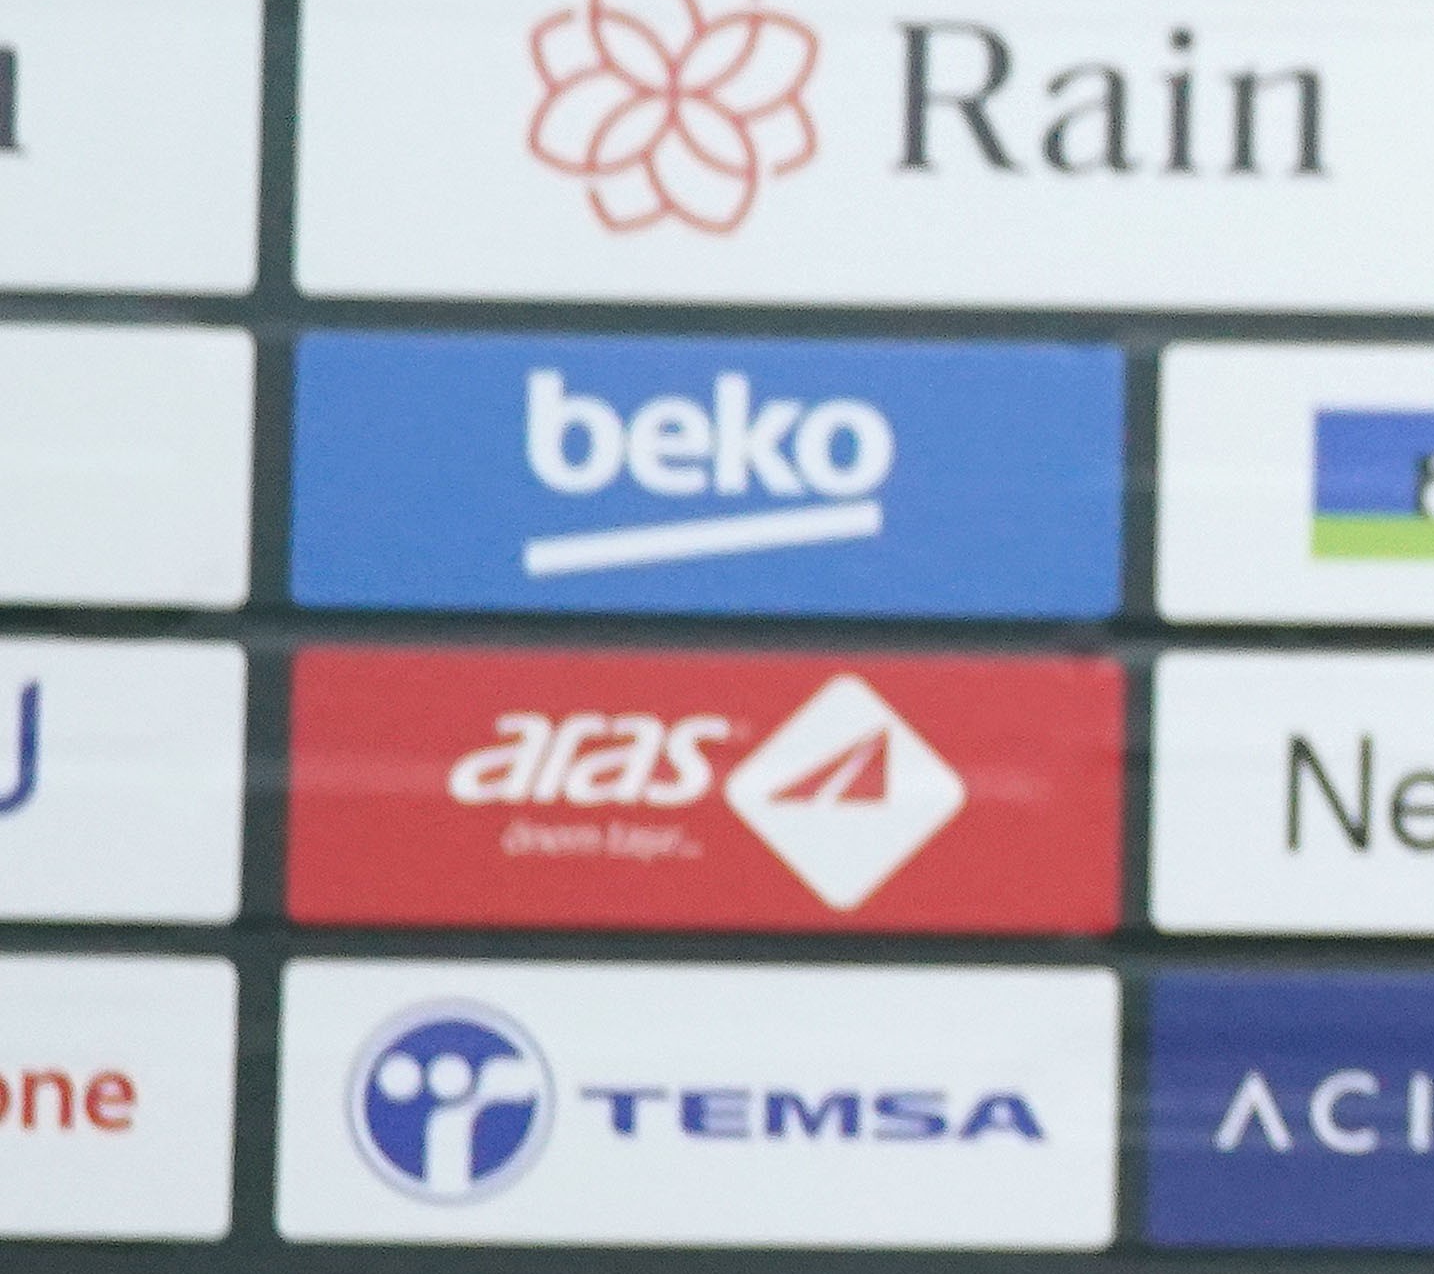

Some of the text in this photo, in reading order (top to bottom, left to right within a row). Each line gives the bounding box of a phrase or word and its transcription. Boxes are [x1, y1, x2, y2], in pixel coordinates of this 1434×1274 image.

[898, 21, 1324, 176] Rain
[526, 369, 895, 500] beko
[446, 712, 731, 809] aras
[582, 1087, 1045, 1142] TEMSA
